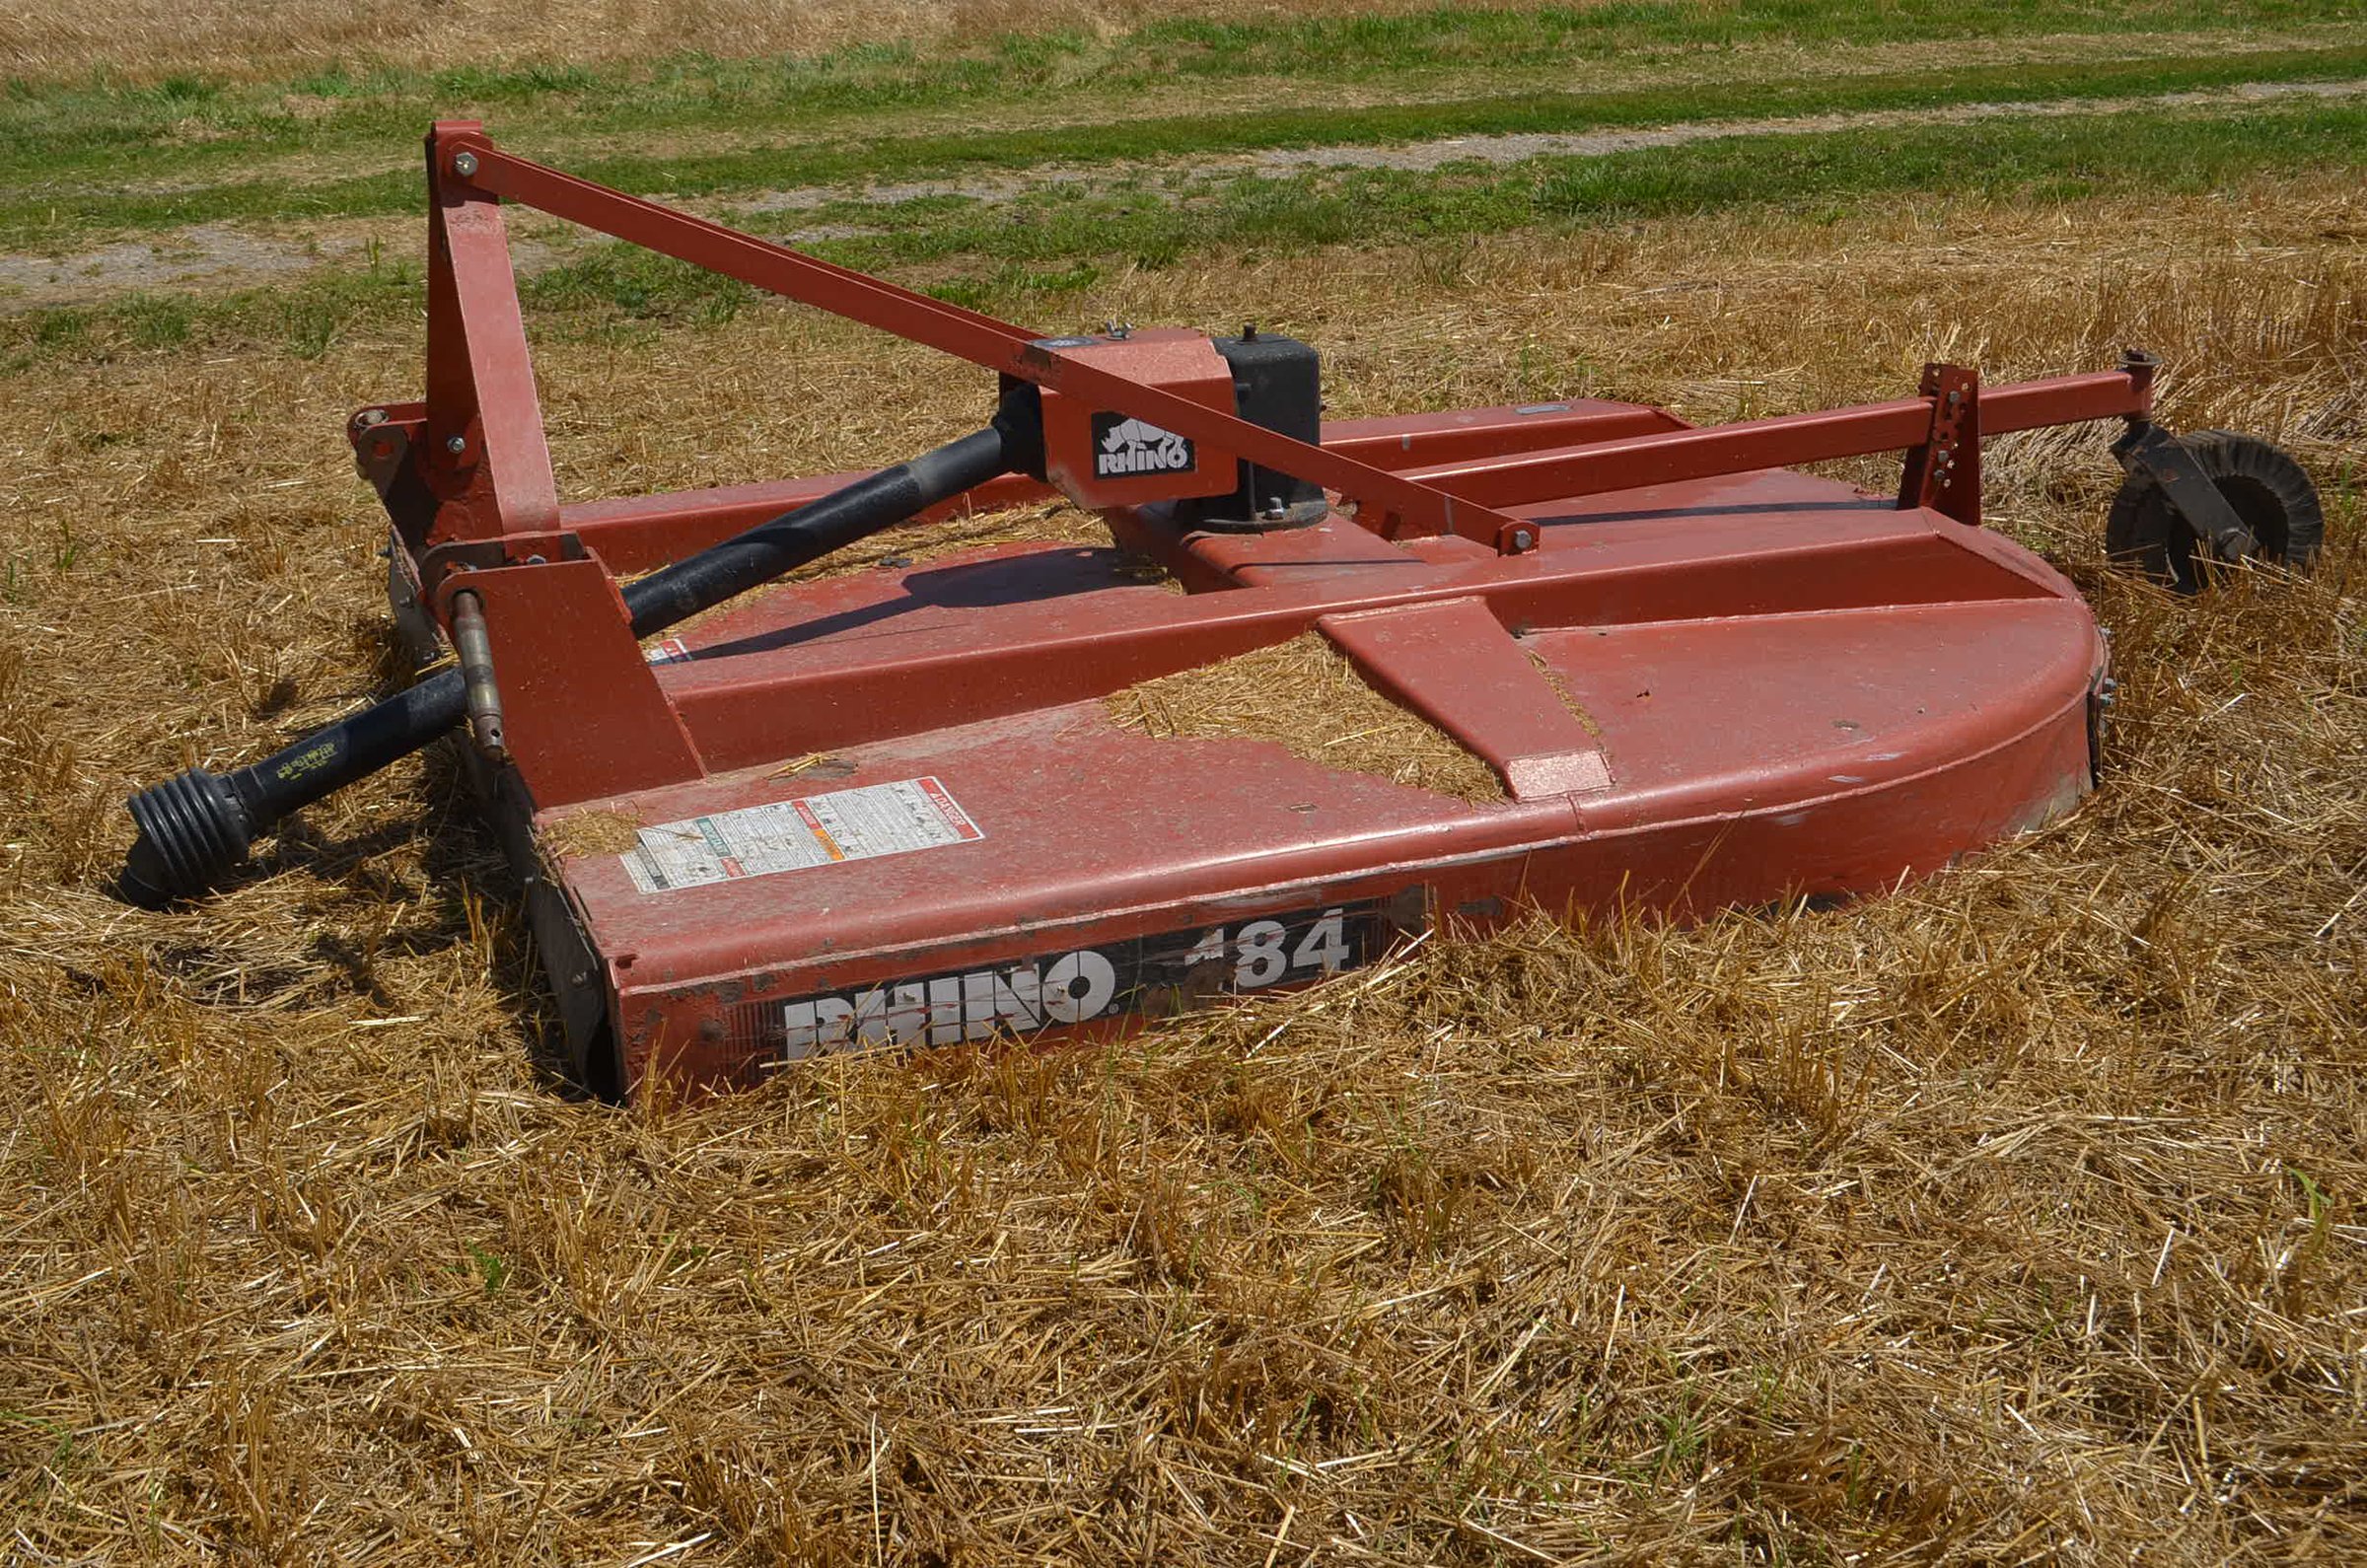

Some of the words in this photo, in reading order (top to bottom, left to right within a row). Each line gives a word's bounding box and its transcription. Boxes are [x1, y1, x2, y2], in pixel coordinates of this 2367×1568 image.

[1099, 450, 1187, 474] RHINO
[933, 796, 967, 825] DANGER
[784, 950, 1116, 1062] RHINO
